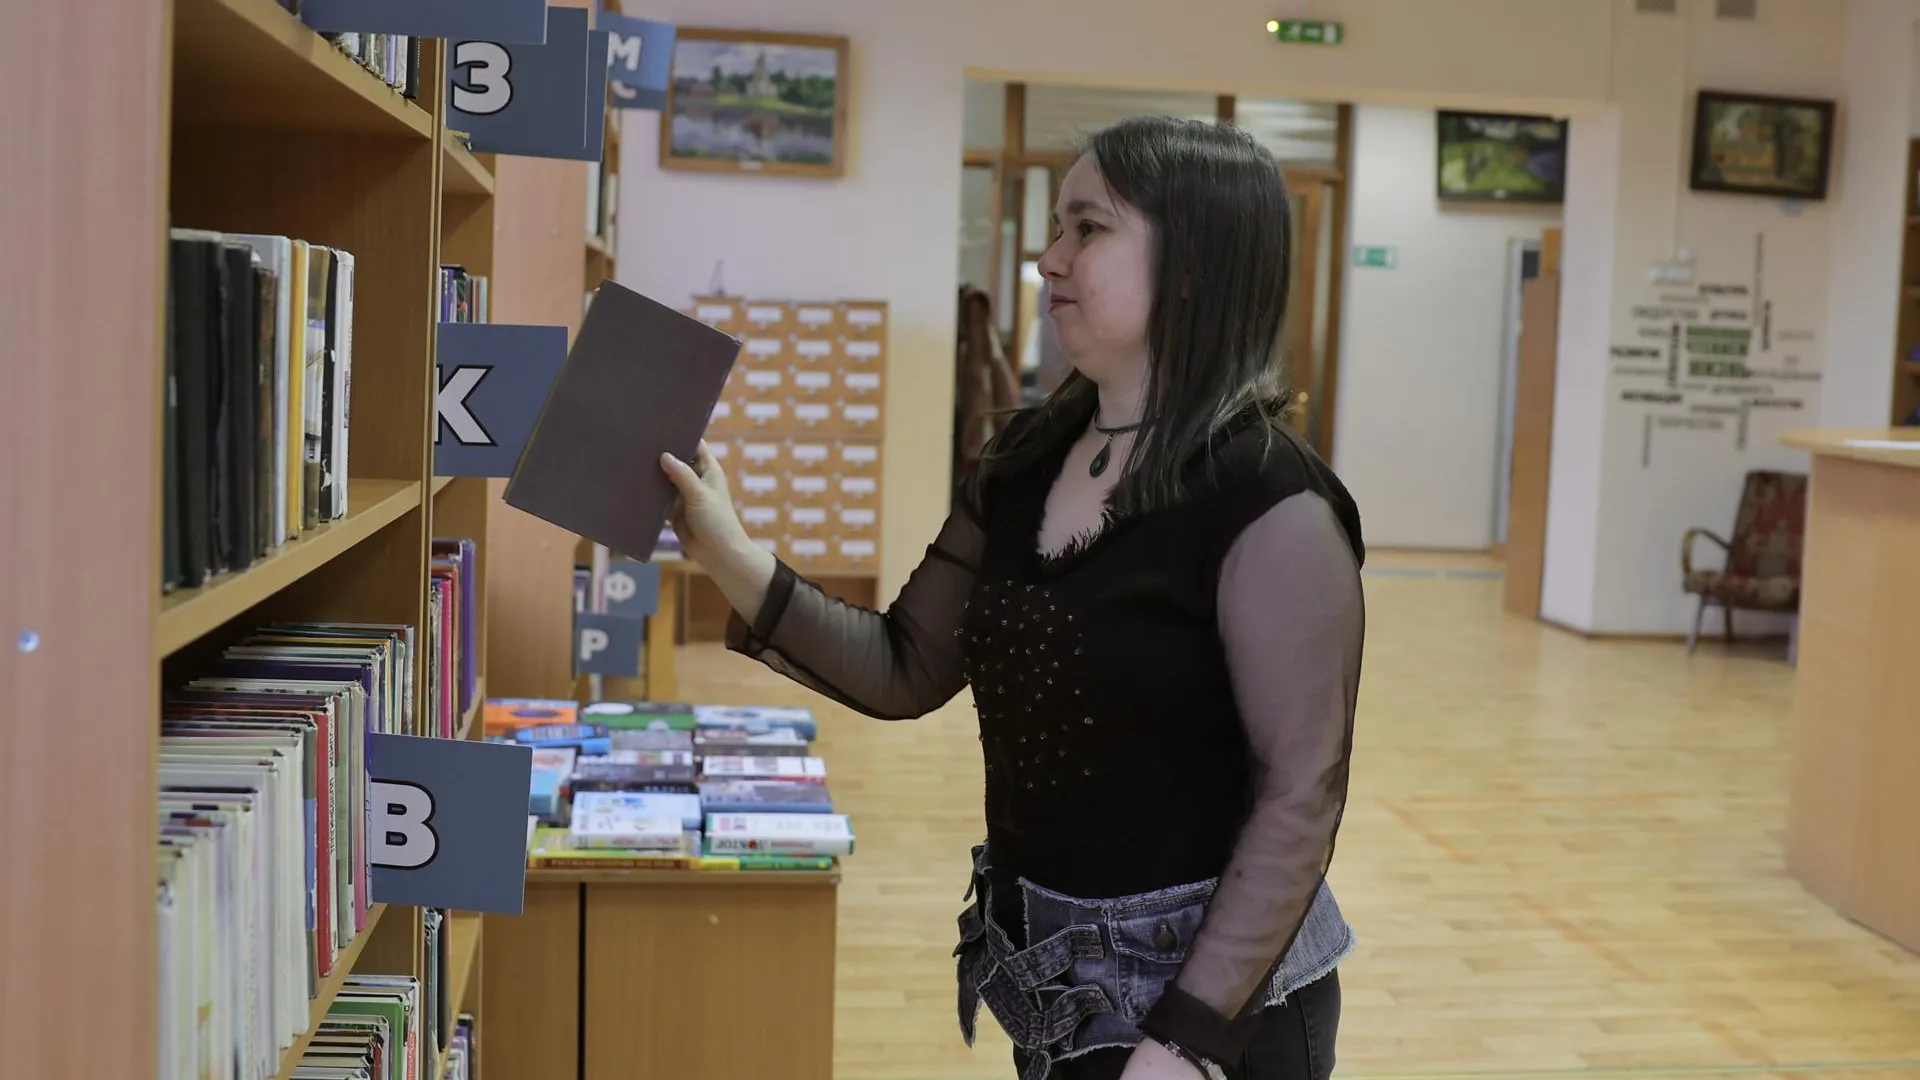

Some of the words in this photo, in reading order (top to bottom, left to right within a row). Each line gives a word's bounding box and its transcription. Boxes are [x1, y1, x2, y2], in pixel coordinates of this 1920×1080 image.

[451, 40, 513, 115] З
[608, 30, 643, 71] М
[434, 364, 498, 447] К
[603, 571, 636, 601] Ф
[580, 628, 609, 662] Р
[371, 777, 440, 871] В
